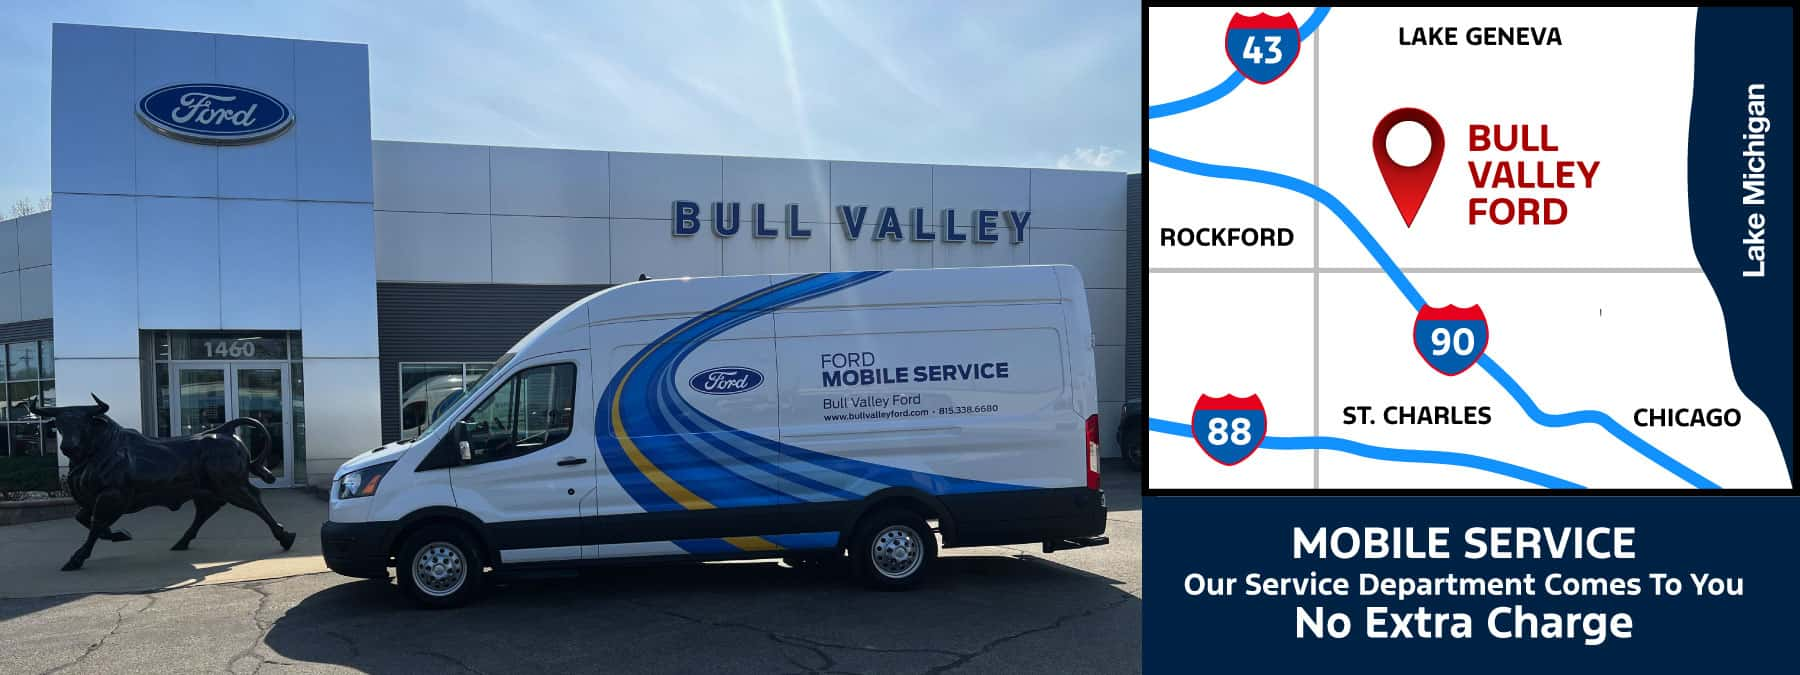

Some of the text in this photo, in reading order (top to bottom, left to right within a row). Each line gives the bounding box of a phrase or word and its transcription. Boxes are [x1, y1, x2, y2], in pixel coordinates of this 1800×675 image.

[171, 92, 258, 127] Ford
[672, 200, 1032, 244] BULL VALLEY
[203, 341, 256, 358] 1460
[821, 352, 876, 369] FORD
[704, 370, 749, 391] Ford
[822, 362, 1009, 388] MOBILE SERVICE
[823, 393, 921, 410] Bull Valley Ford
[823, 404, 998, 422] www.bullvalleyford.com 815.338.6680
